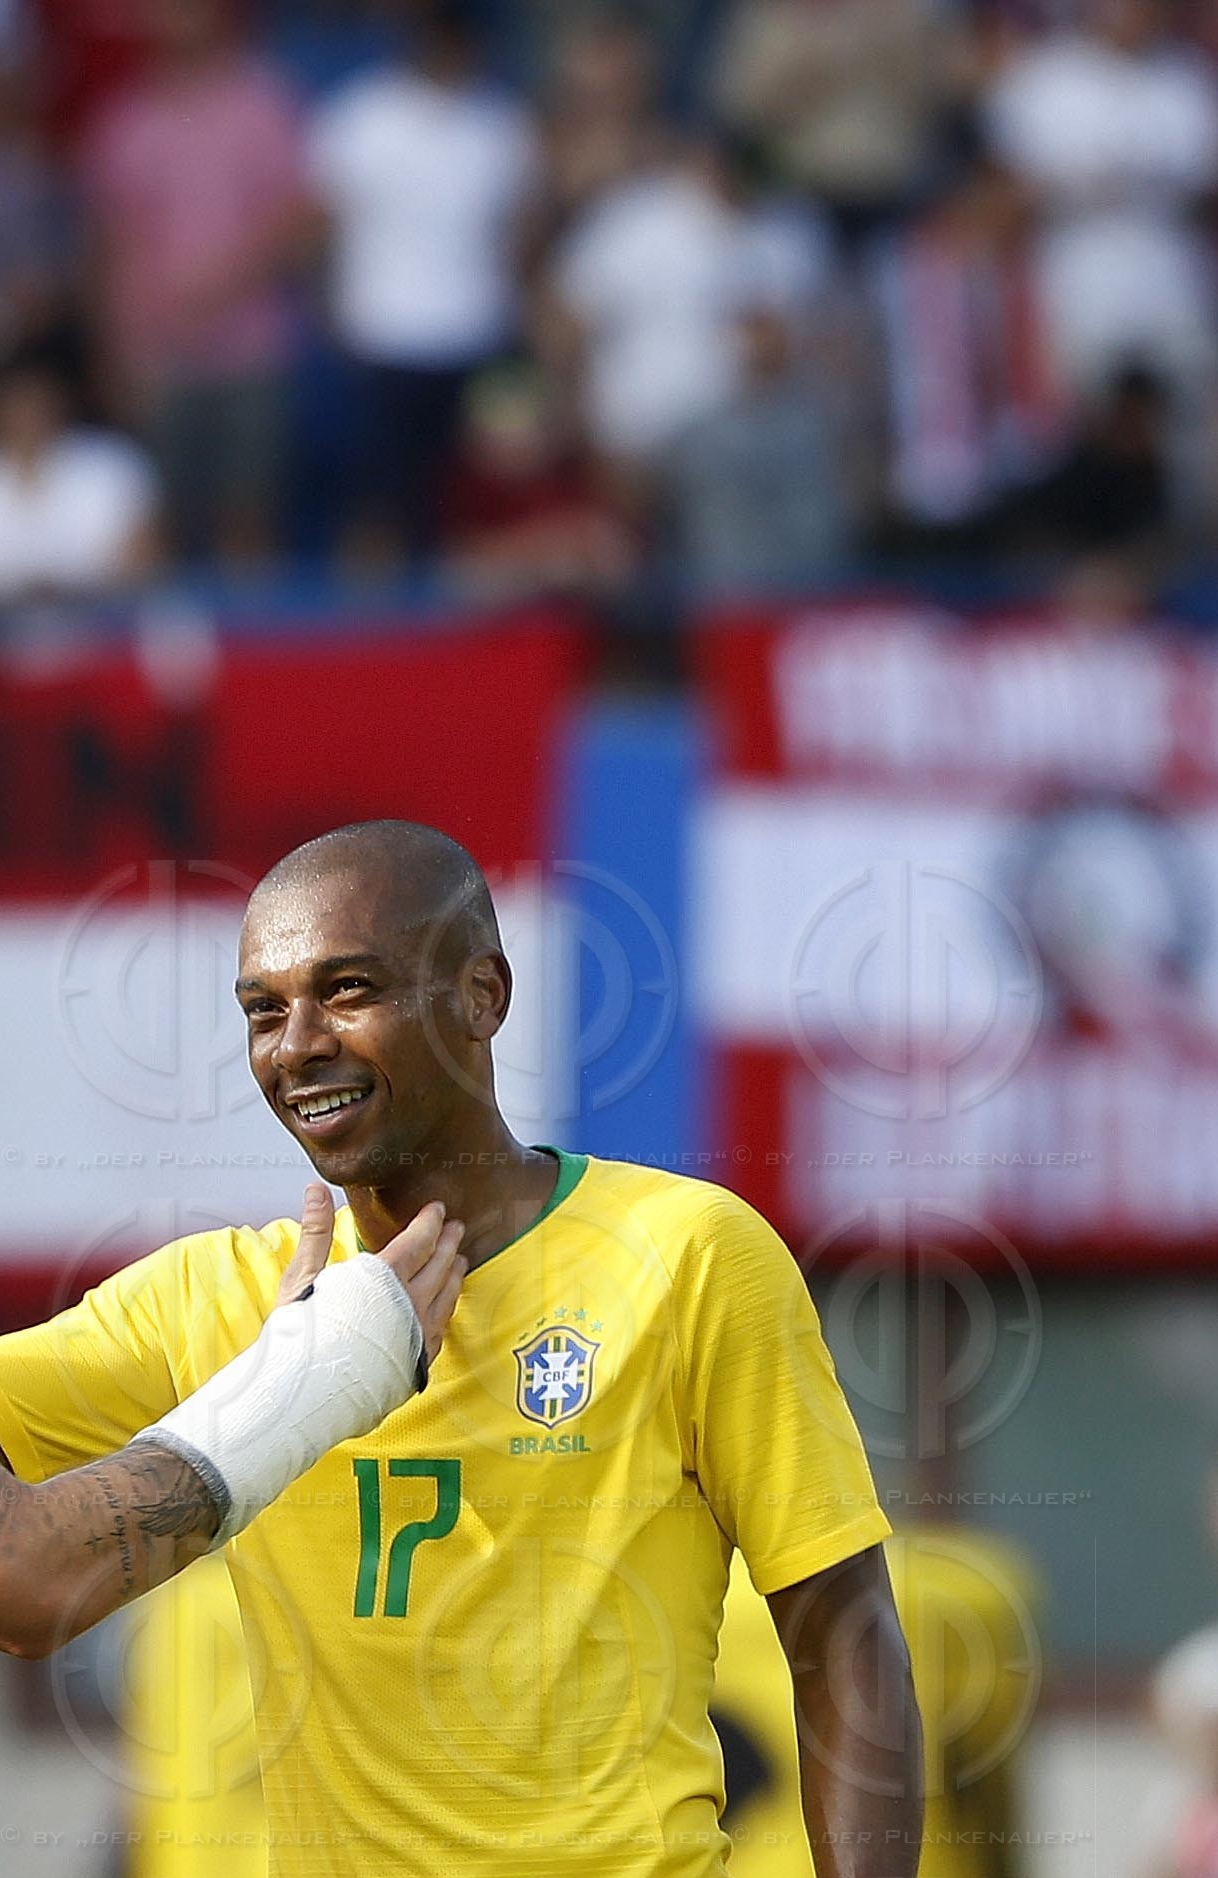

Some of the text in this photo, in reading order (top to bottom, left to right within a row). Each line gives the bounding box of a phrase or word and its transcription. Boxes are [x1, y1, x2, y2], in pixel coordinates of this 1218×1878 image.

[542, 1370, 570, 1383] CBF
[509, 1436, 591, 1455] BRASIL
[353, 1458, 461, 1617] 17
